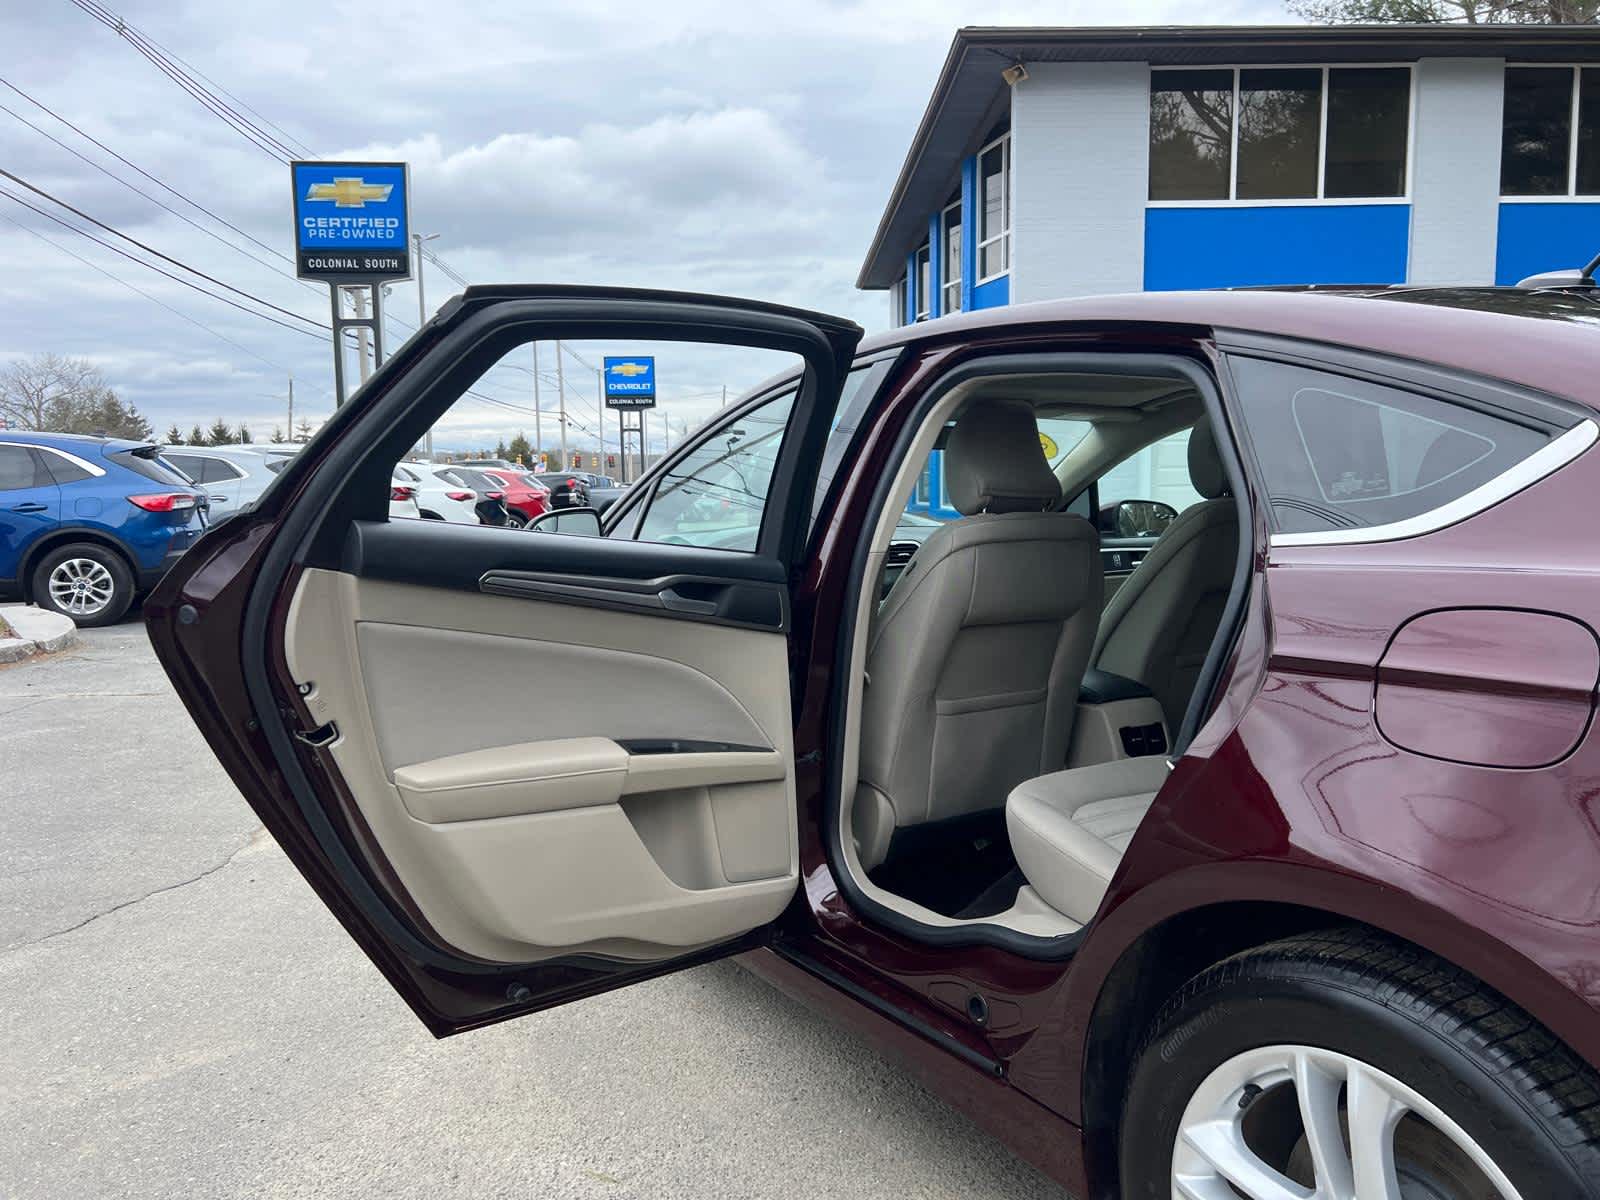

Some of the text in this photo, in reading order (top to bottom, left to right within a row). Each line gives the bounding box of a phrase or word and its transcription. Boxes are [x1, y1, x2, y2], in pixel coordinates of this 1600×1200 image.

[303, 217, 399, 228] CERTIFIED
[309, 229, 395, 239] PRE-OWNED
[308, 259, 398, 268] COLONIAL SOUTH
